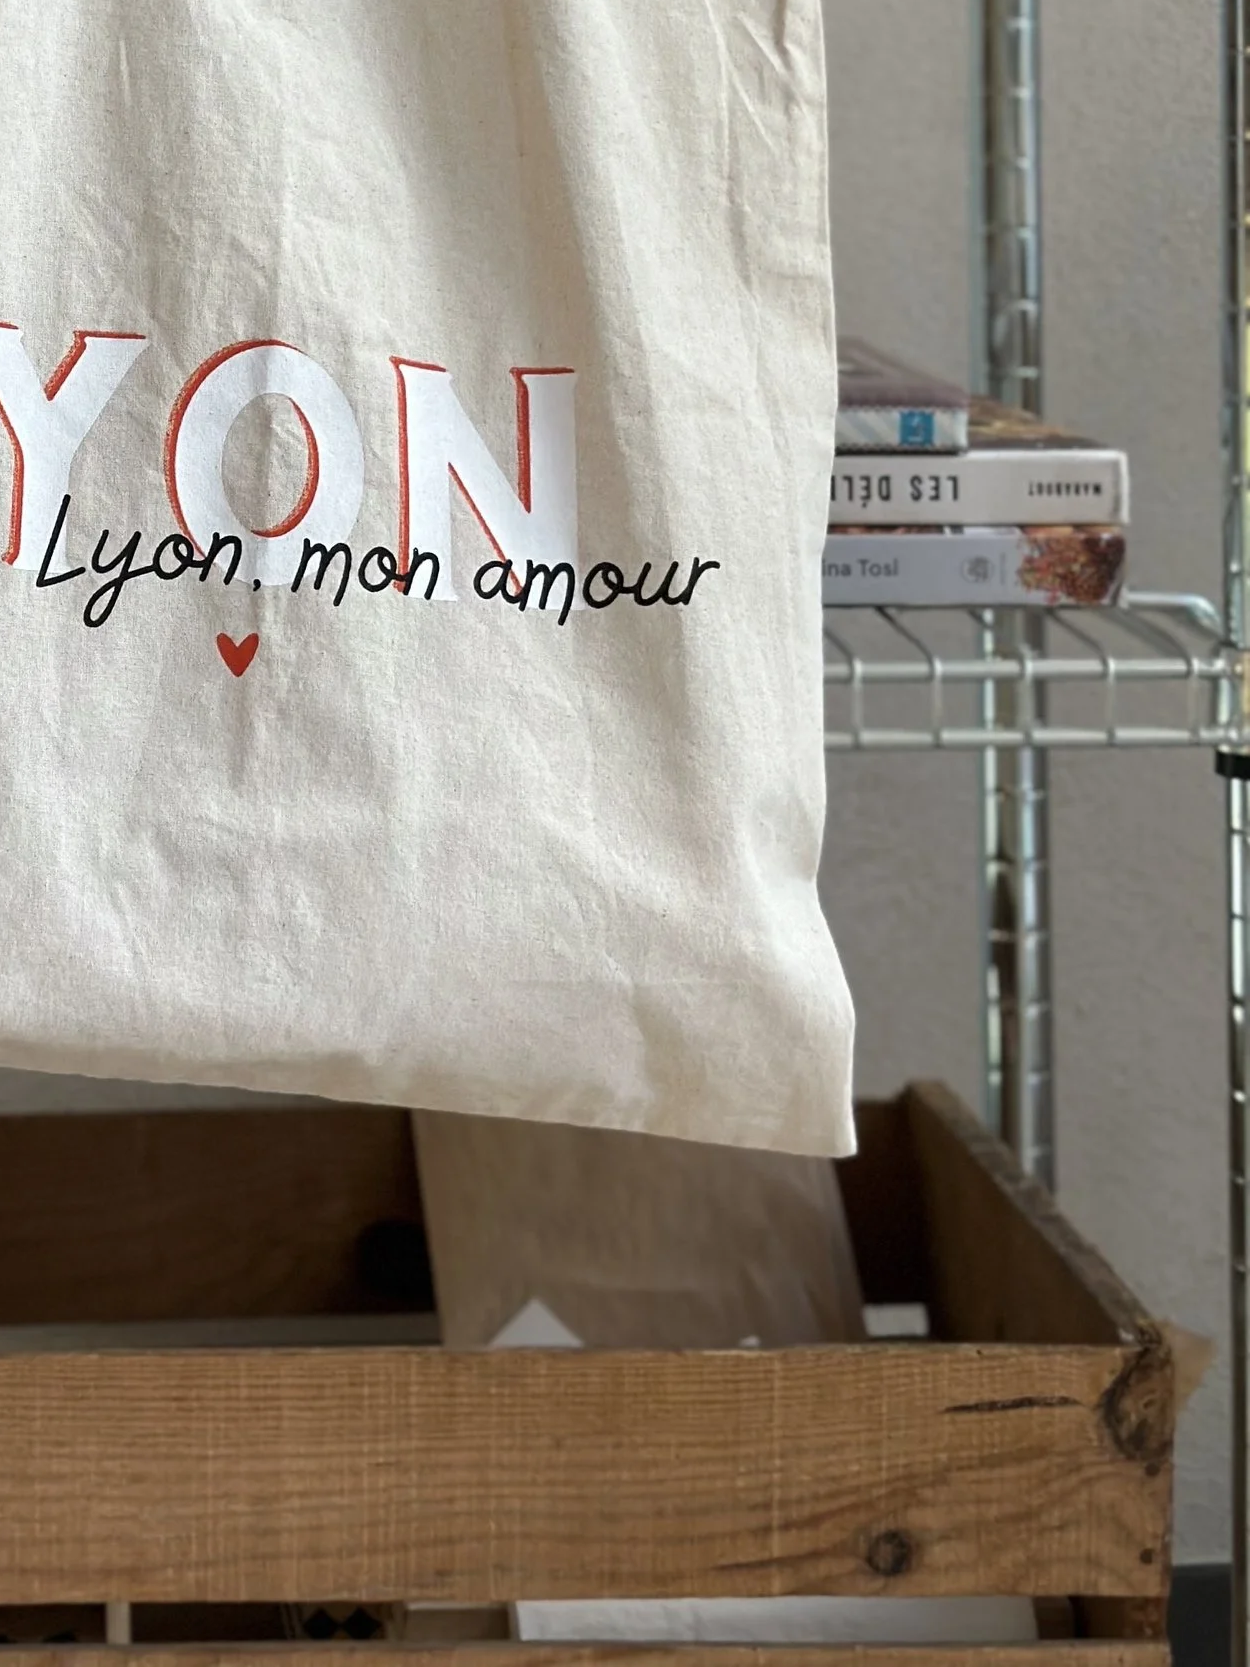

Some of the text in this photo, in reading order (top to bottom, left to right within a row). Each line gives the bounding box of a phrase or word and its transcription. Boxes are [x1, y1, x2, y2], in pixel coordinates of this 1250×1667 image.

[909, 474, 960, 502] LES
[1027, 481, 1103, 497] MARABOUT
[35, 492, 721, 628] Lyon, mon amour
[857, 558, 900, 577] Tosi
